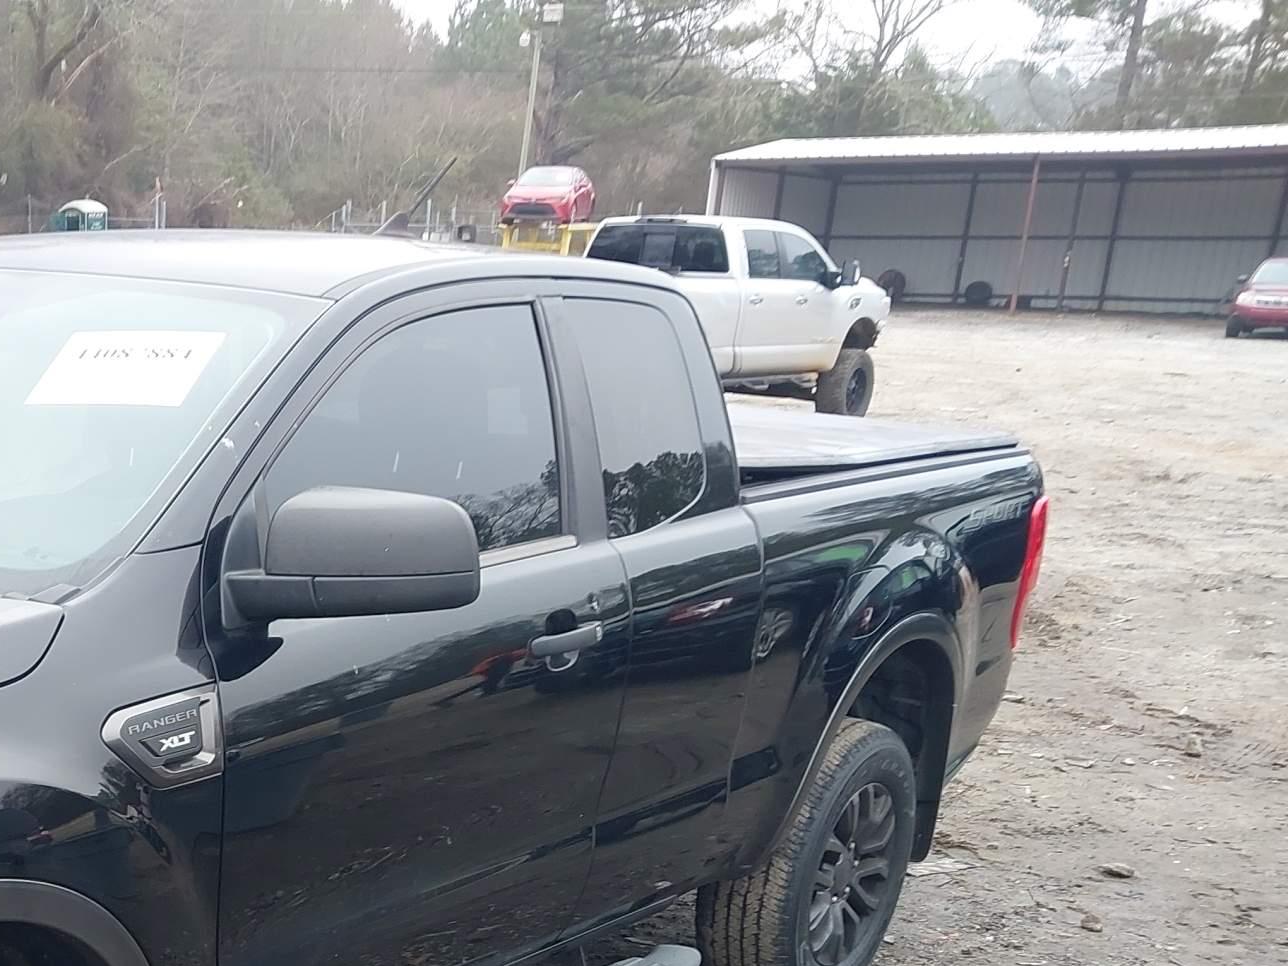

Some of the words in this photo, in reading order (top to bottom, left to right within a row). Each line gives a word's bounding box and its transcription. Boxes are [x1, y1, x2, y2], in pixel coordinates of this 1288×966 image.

[958, 501, 1030, 536] SPORT
[127, 708, 198, 735] RANGER
[159, 730, 196, 752] XLT
